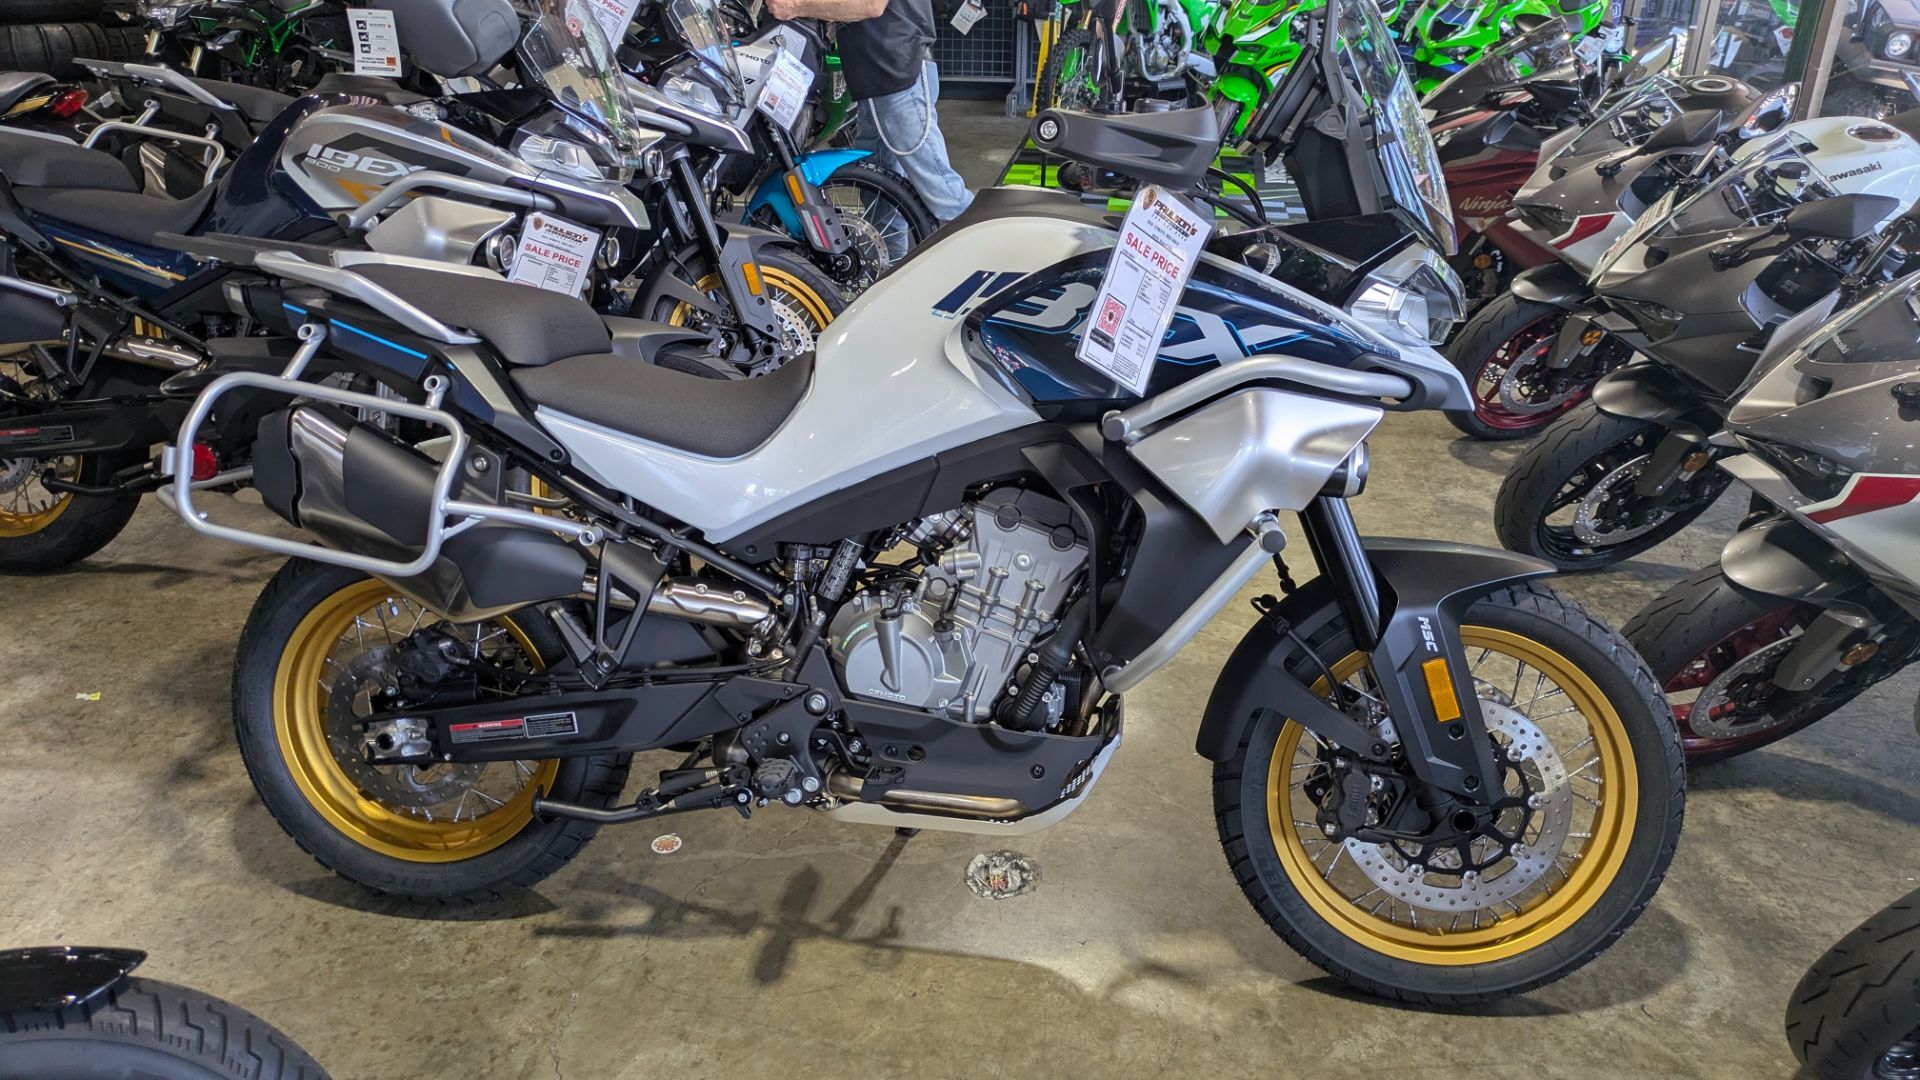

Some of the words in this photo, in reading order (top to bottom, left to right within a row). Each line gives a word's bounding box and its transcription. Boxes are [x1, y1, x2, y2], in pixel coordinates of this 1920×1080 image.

[601, 0, 626, 17] PRICE
[1825, 161, 1883, 183] awasaki
[1458, 194, 1512, 215] Ninja
[524, 243, 550, 258] SALE
[552, 252, 582, 268] PRICE
[1125, 232, 1152, 258] SALE
[1151, 251, 1181, 280] PRICE
[1417, 616, 1439, 653] MSC
[868, 688, 906, 702] CFMOTO
